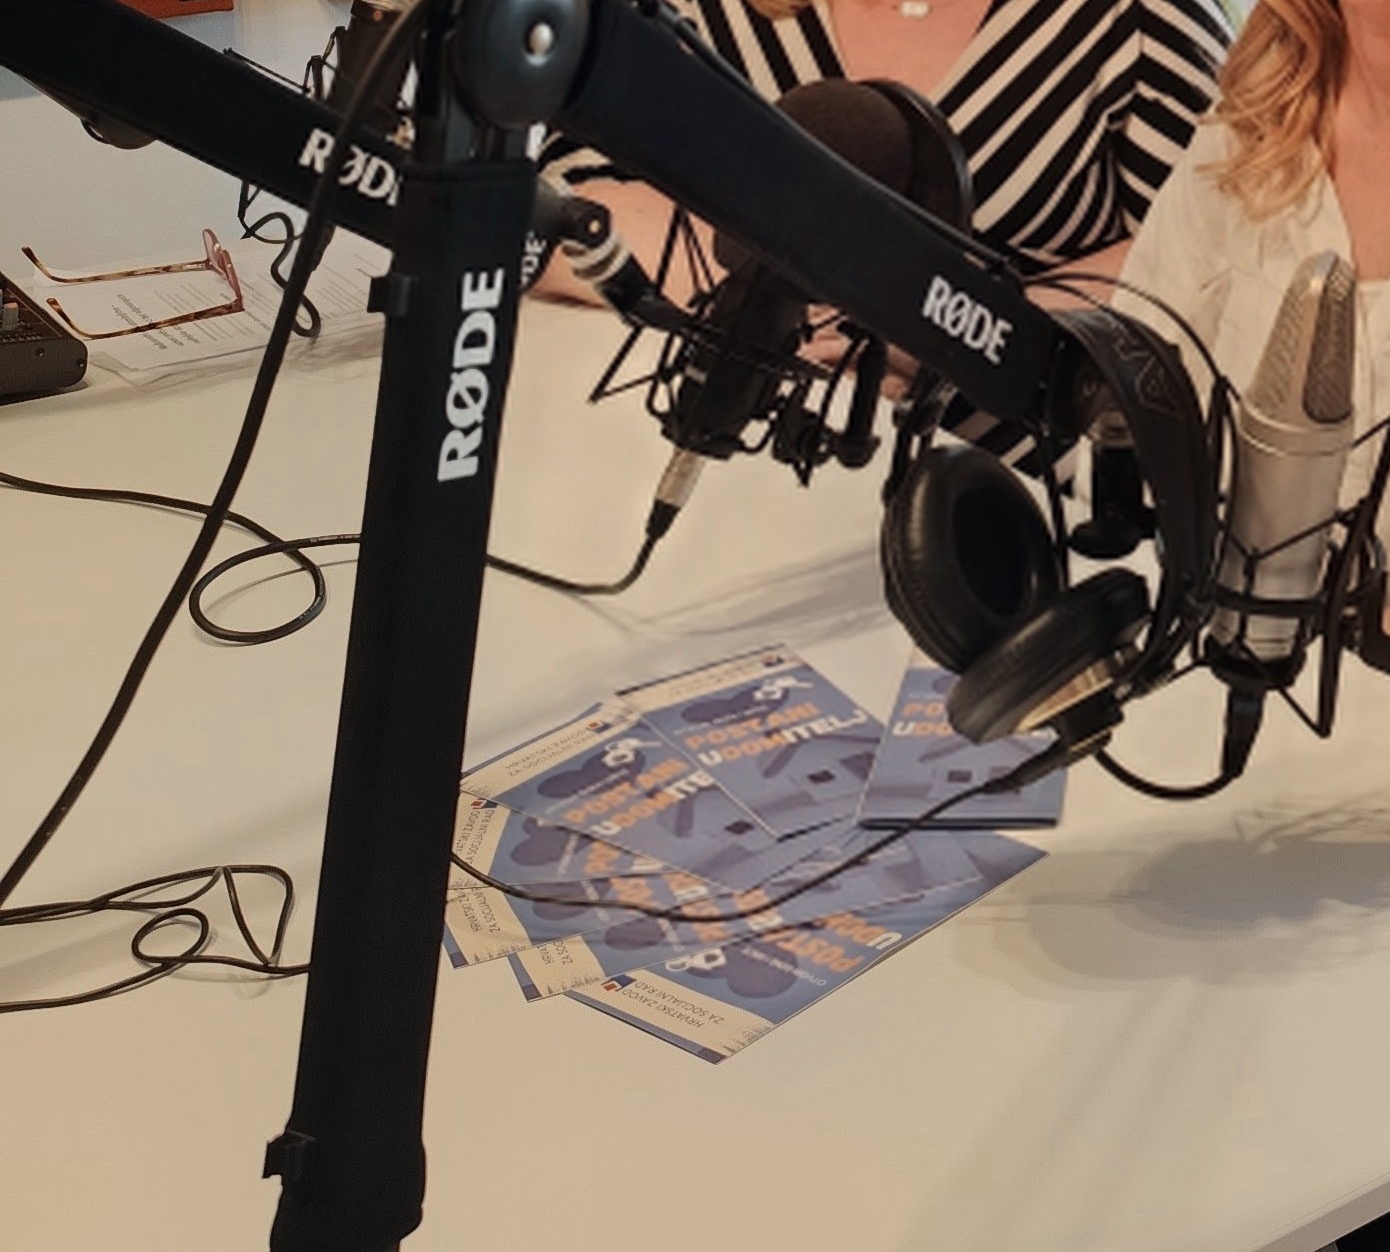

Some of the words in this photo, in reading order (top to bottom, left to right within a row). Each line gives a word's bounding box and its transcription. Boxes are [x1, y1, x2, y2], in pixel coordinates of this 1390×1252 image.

[922, 274, 1014, 365] RØDE
[436, 267, 505, 483] RØDE
[622, 988, 658, 1008] ZAVOD
[634, 981, 658, 994] RAD
[656, 1004, 705, 1028] HRVATSKI
[708, 1013, 726, 1025] ZA
